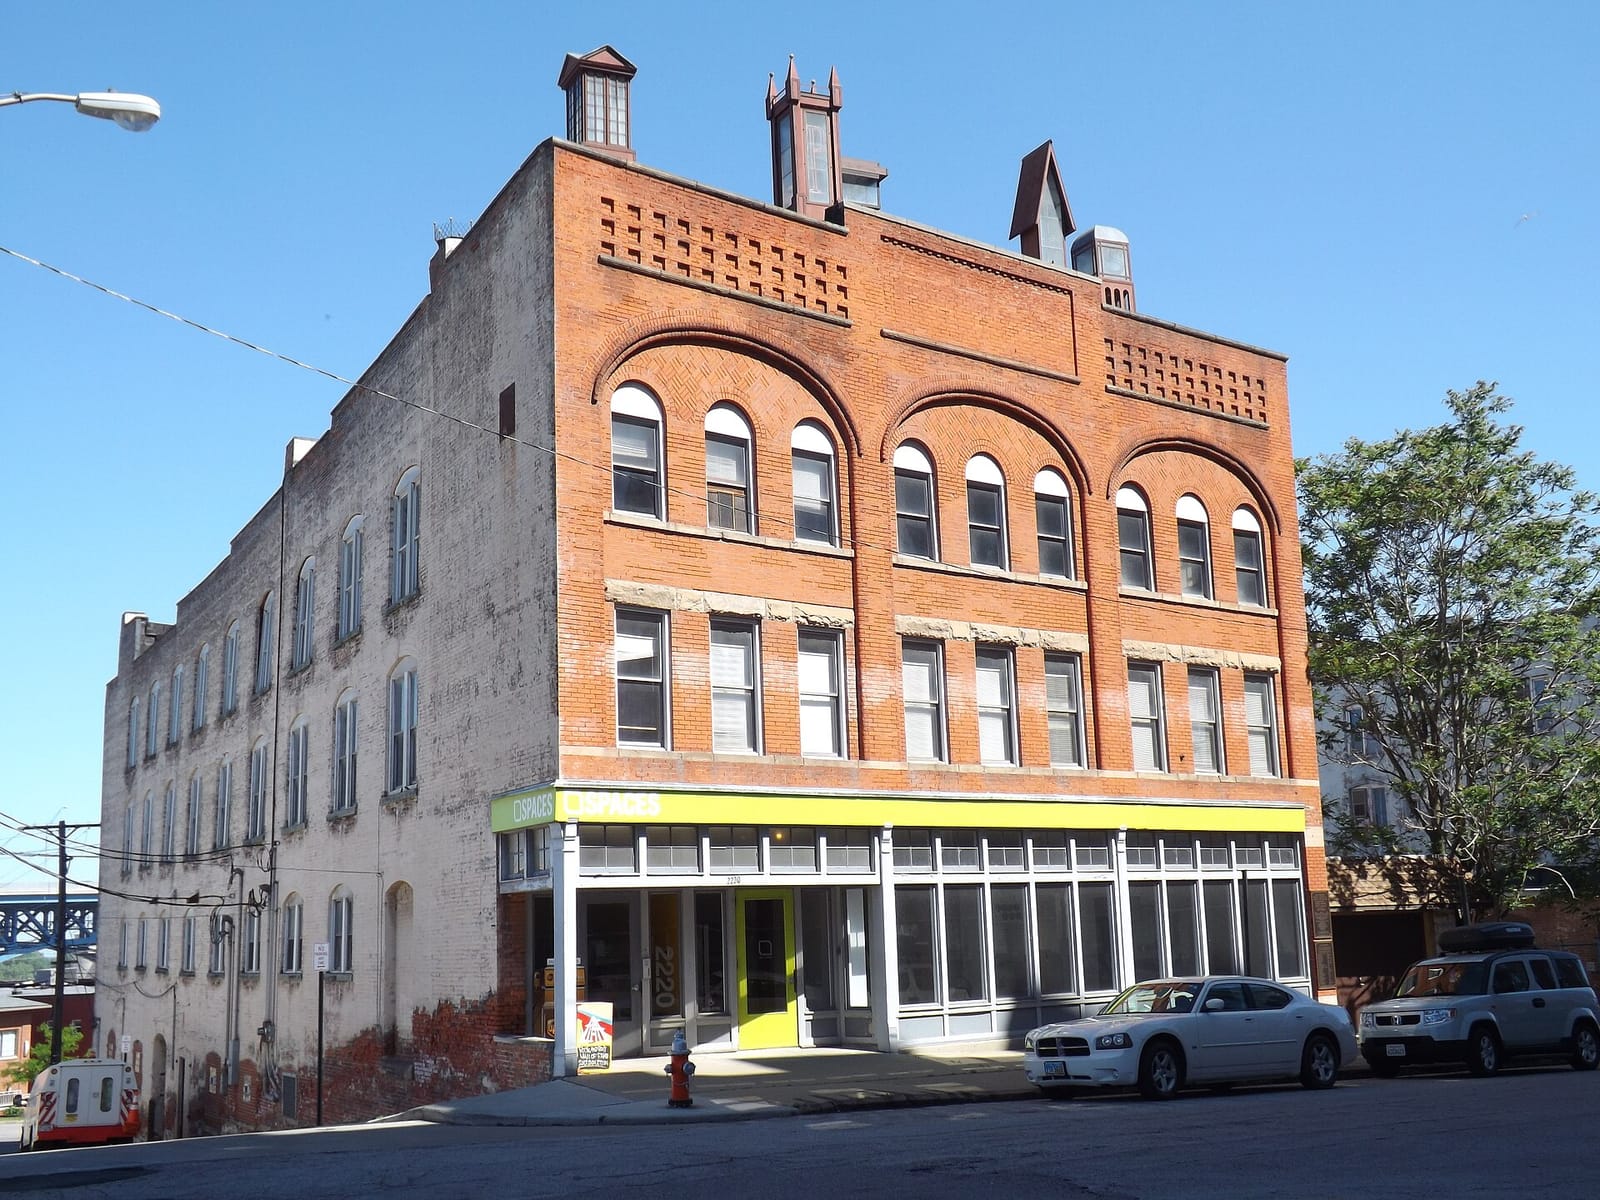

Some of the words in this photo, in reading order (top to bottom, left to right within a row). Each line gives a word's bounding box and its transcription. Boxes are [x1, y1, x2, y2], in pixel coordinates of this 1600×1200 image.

[521, 793, 553, 822] SPACES
[583, 792, 661, 817] SPACES
[727, 876, 741, 885] 2220
[655, 946, 674, 1008] 2220
